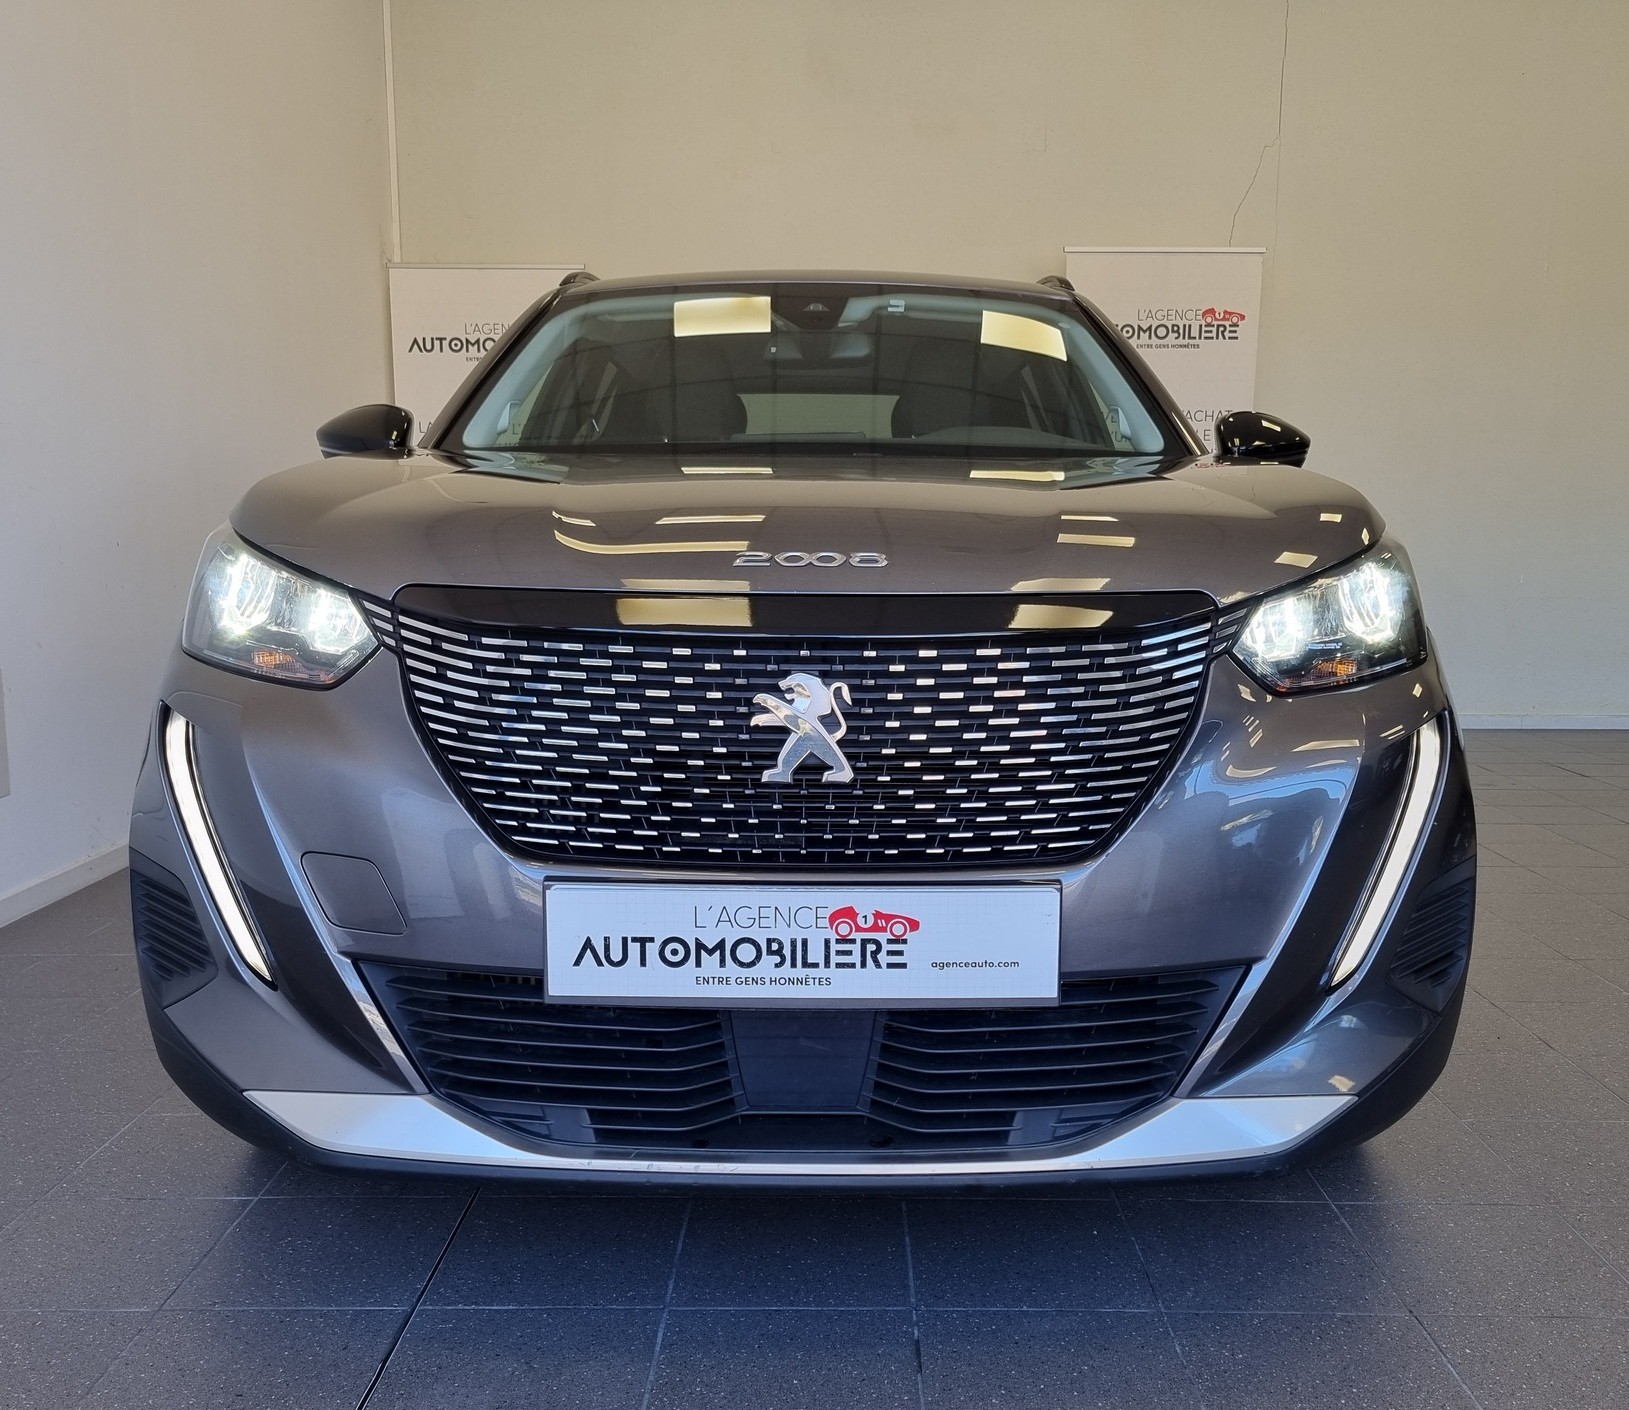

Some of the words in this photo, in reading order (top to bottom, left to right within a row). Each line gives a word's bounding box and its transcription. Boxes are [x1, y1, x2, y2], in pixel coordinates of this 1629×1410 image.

[1137, 309, 1202, 321] L'AGENCE
[1115, 324, 1239, 340] OMOBILIERE
[733, 552, 888, 567] 2008
[694, 905, 828, 929] L'AGENCE
[572, 936, 908, 969] AUTOMOBILIERE
[931, 960, 1020, 970] agenceauto.com
[696, 977, 732, 986] ENTRE
[735, 977, 766, 986] GENS
[769, 974, 832, 986] HONNÊTES
